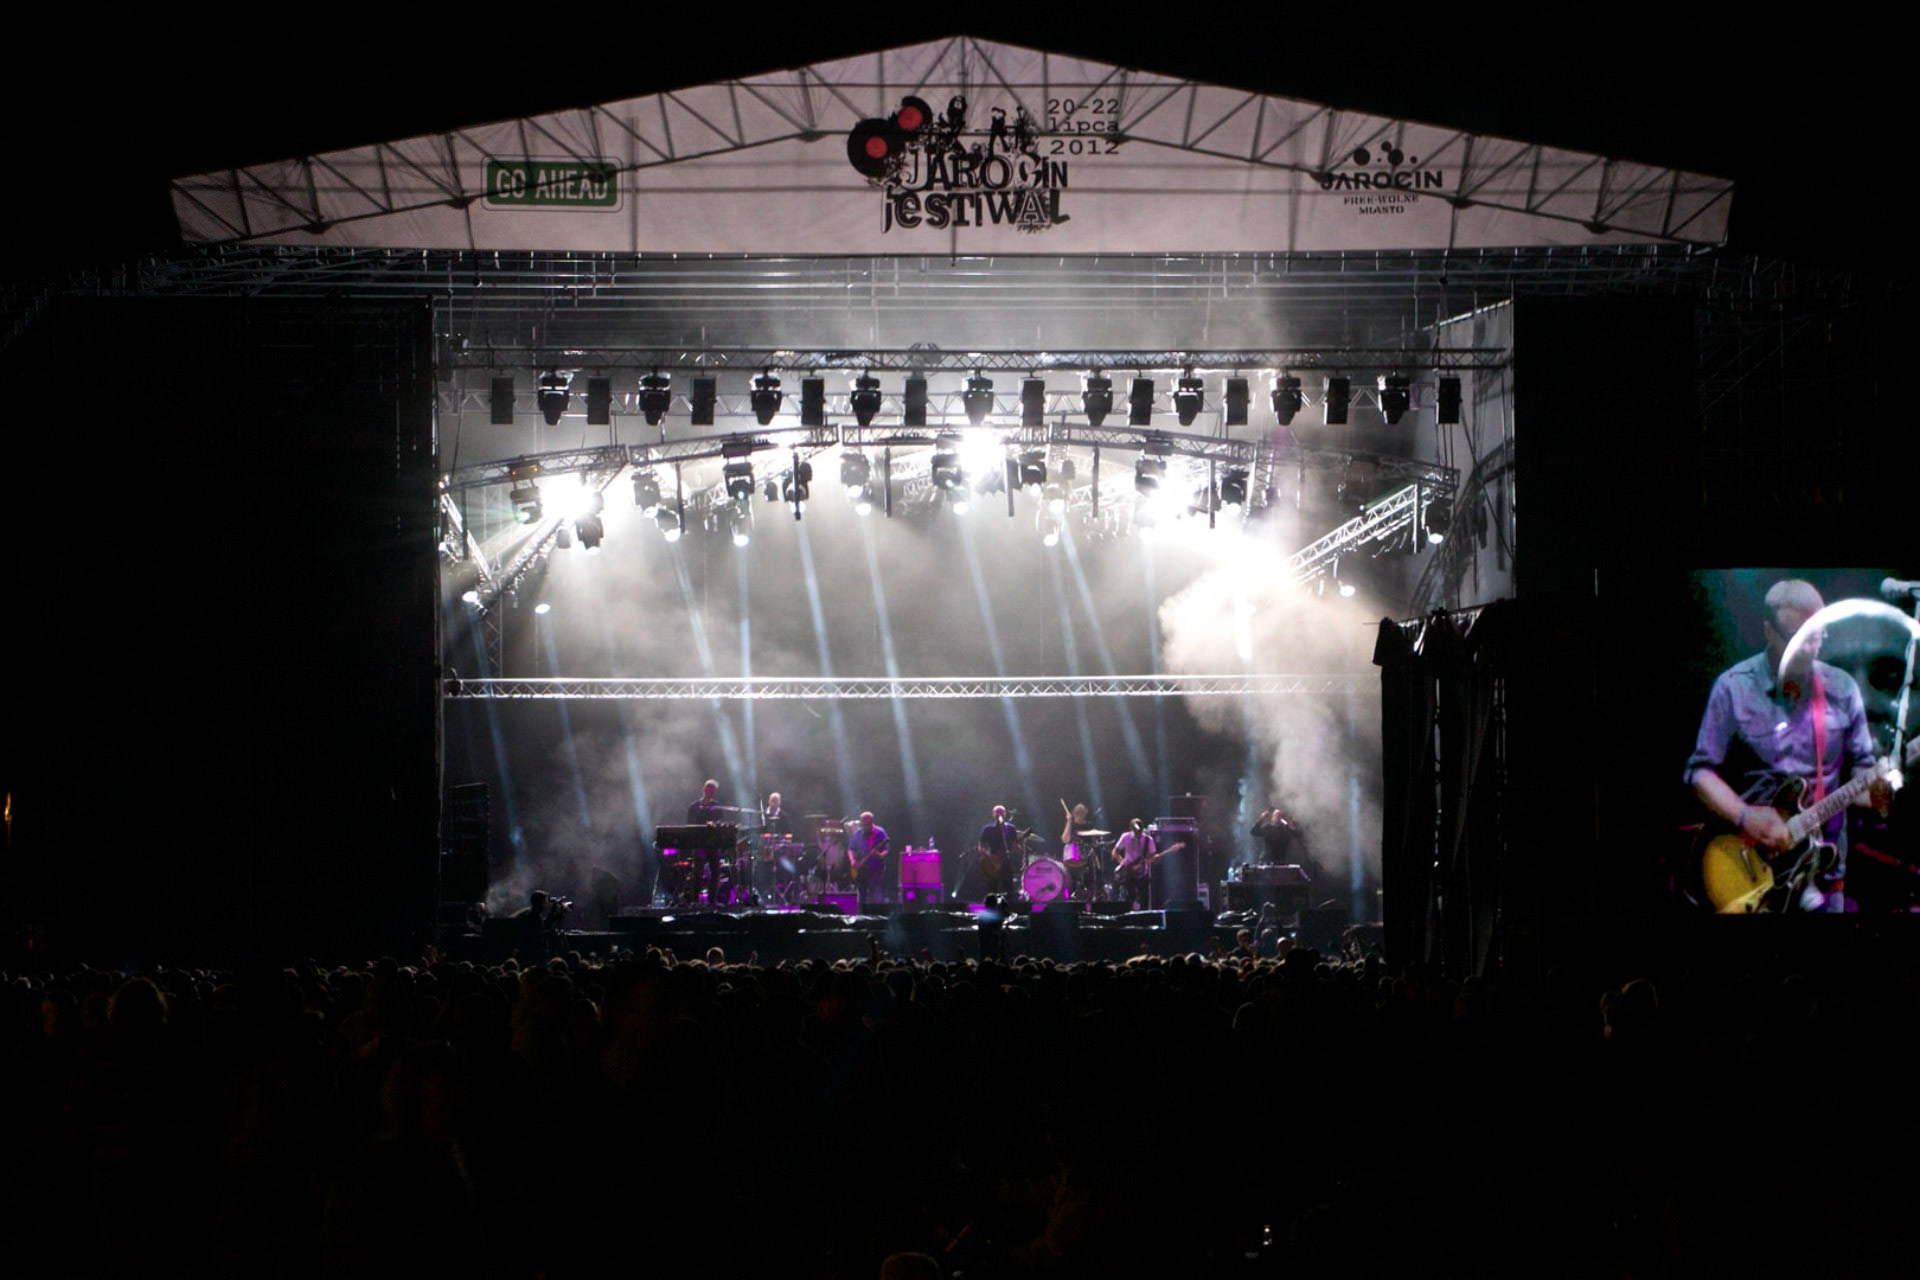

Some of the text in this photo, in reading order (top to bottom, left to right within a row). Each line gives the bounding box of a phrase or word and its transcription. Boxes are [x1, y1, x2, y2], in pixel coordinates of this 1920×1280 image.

[1047, 98, 1120, 115] 20-22
[1049, 116, 1120, 136] lipca
[1049, 139, 1120, 155] 2012
[901, 146, 1068, 190] JAROCIN
[496, 169, 608, 200] GO AHEAD
[1320, 170, 1443, 190] JAROCIN
[1359, 205, 1404, 215] MIASTO
